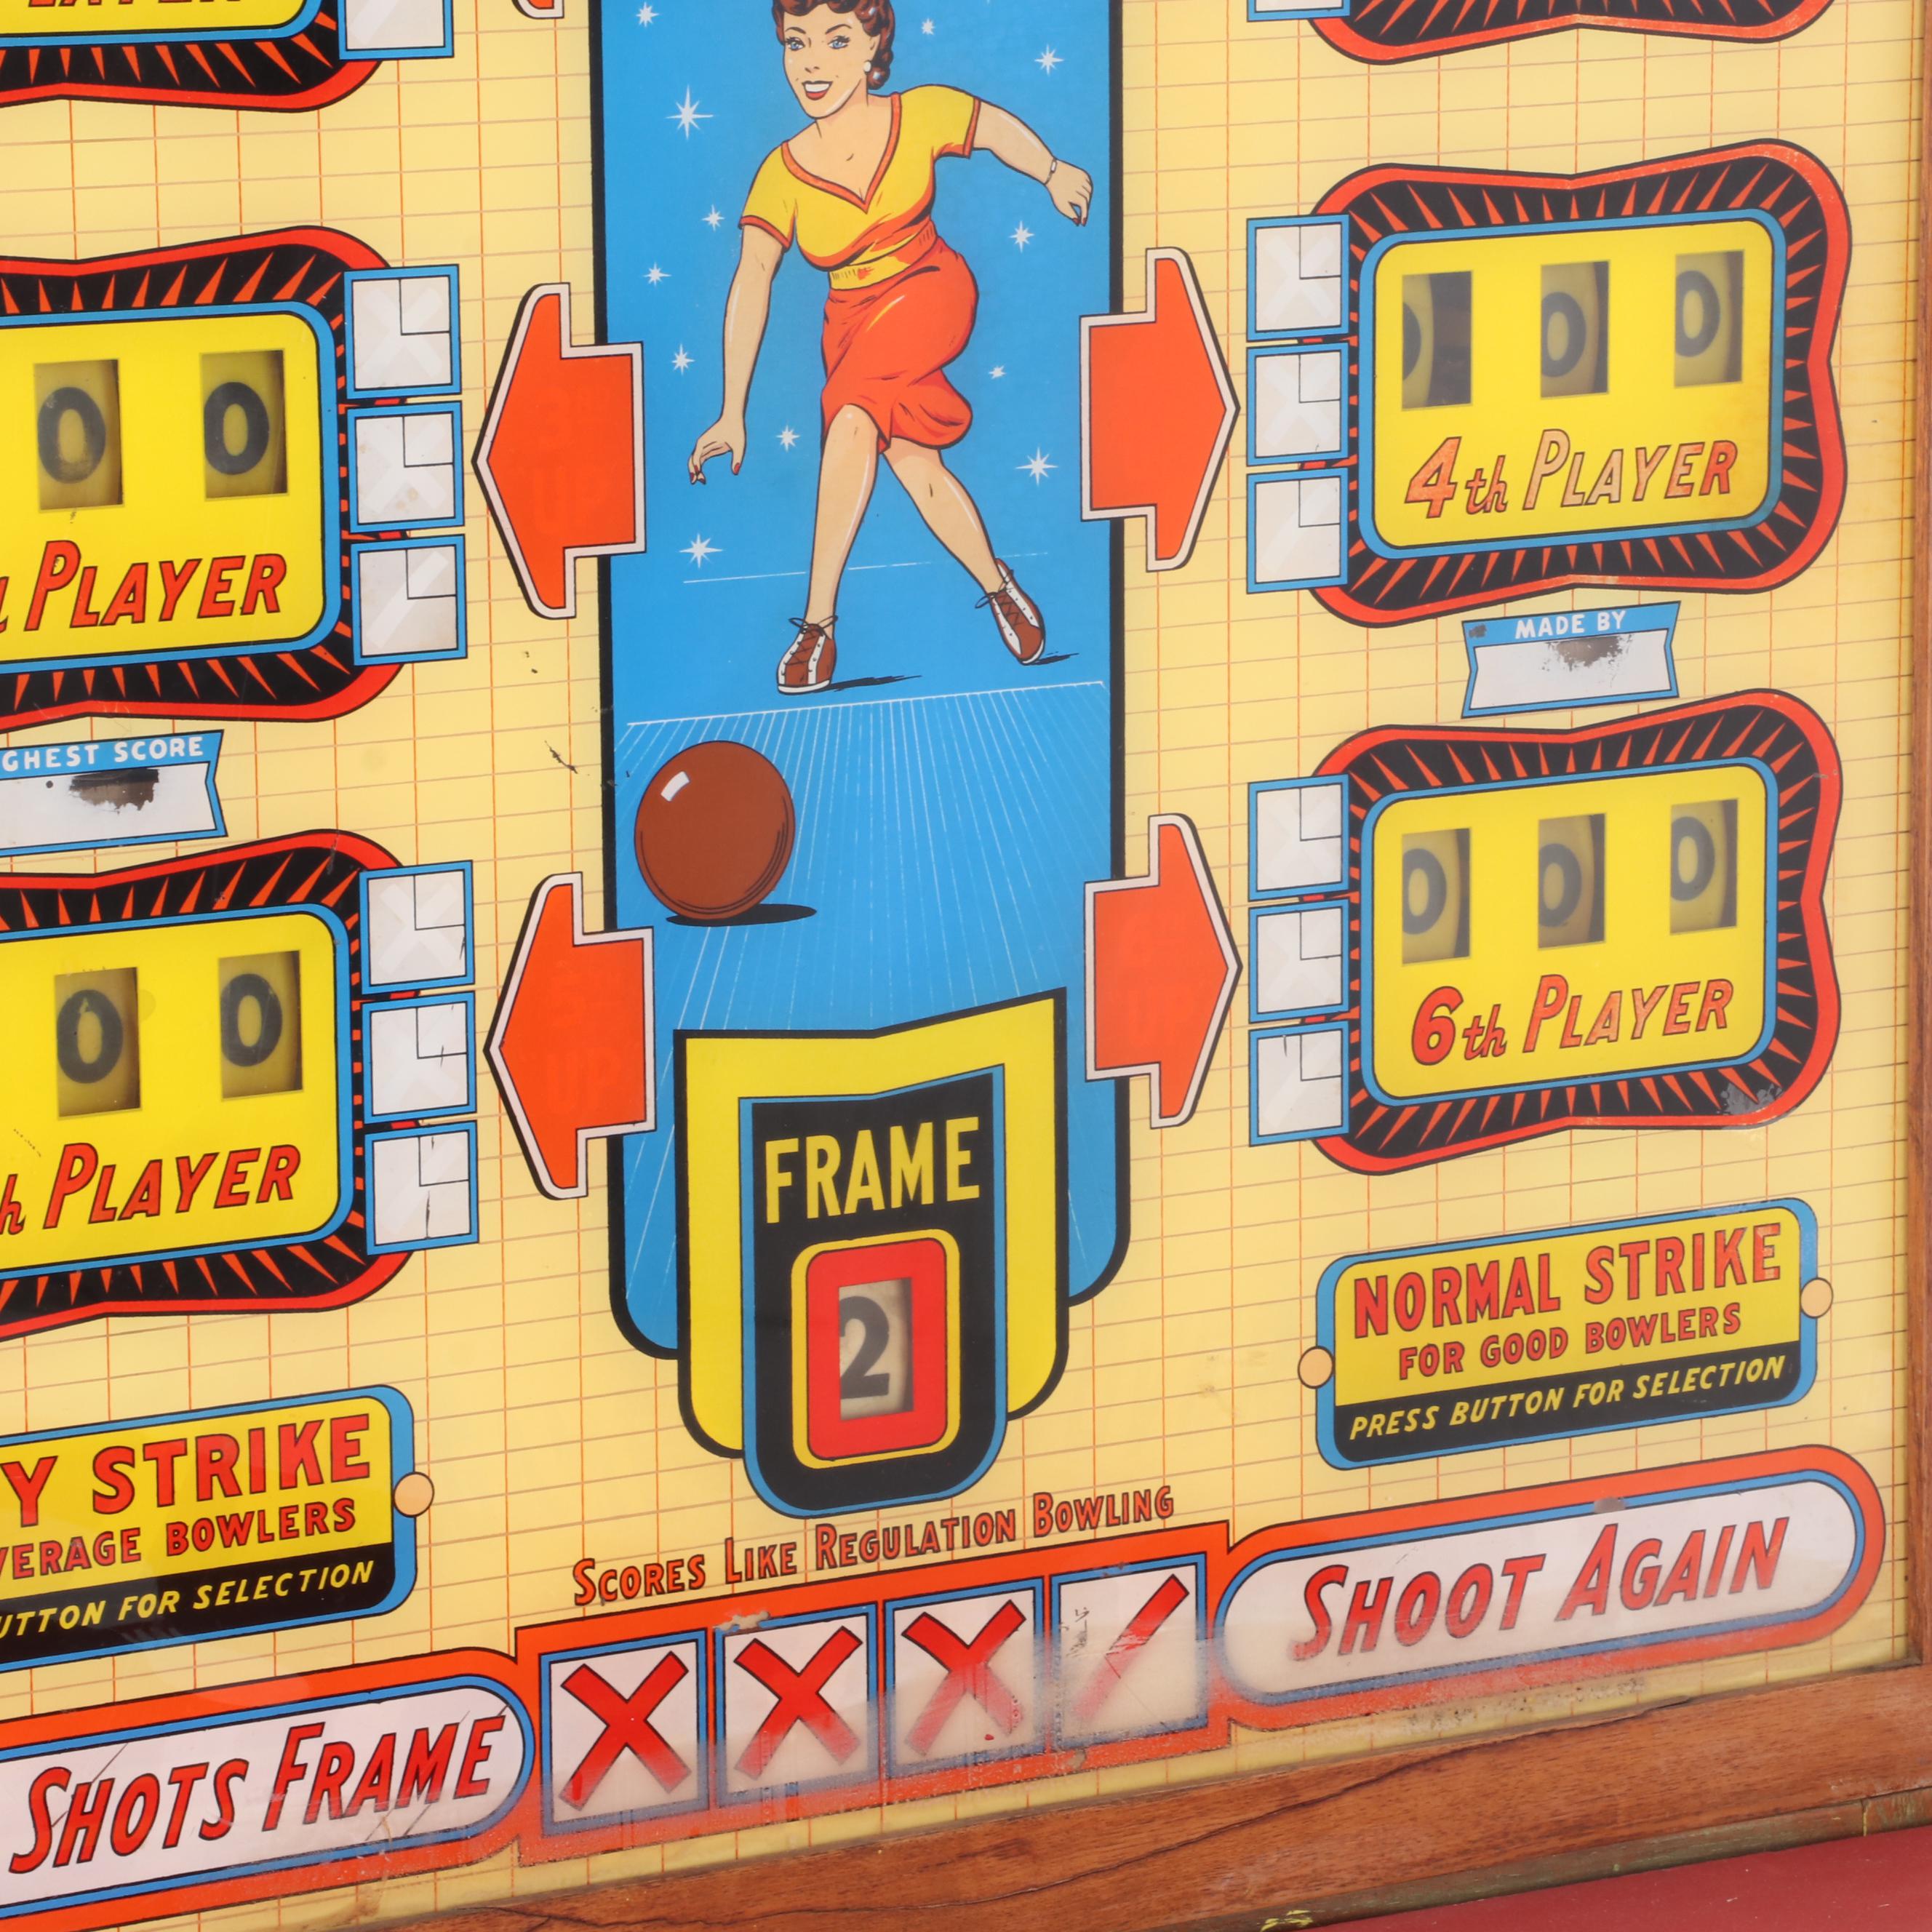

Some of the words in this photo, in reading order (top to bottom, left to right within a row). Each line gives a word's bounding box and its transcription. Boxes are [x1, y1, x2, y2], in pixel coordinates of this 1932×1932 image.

[1404, 437, 1508, 519] 4th
[1522, 428, 1737, 511] PLAYER
[23, 540, 287, 631] PLAYER
[1514, 614, 1584, 639] MADE
[1597, 610, 1626, 632] BY
[2, 745, 100, 772] GHEST
[114, 736, 204, 762] SCORE
[1410, 986, 1507, 1065] 6th
[1522, 974, 1733, 1053] PLAYER
[43, 1142, 300, 1229] PLAYER
[765, 1117, 981, 1224] FRAME
[1354, 1253, 1561, 1338] NORMAL
[1584, 1222, 1781, 1304] STRIKE
[839, 1295, 891, 1399] 2
[1399, 1341, 1465, 1381] FOR
[1480, 1327, 1568, 1369] GOOD
[1586, 1302, 1741, 1355] BOWLERS
[1349, 1406, 1439, 1441] PRESS
[1450, 1387, 1565, 1427] BUTTON
[1573, 1379, 1623, 1408] FOR
[1633, 1354, 1785, 1400] SELECTION
[0, 1456, 58, 1528] Y
[92, 1414, 370, 1514] STRIKE
[166, 1498, 356, 1557] BOWLERS
[572, 1554, 706, 1605] SCORES
[726, 1536, 797, 1586] LIKE
[815, 1512, 1015, 1571] REGULATION
[1034, 1485, 1174, 1538] BOWLING
[118, 1591, 177, 1621] FOR
[193, 1560, 374, 1610] SELECTION
[1293, 1554, 1546, 1661] SHOOT
[1554, 1517, 1789, 1621] AGAIN
[9, 1758, 249, 1874] SHOTS
[263, 1722, 506, 1832] FRAME
